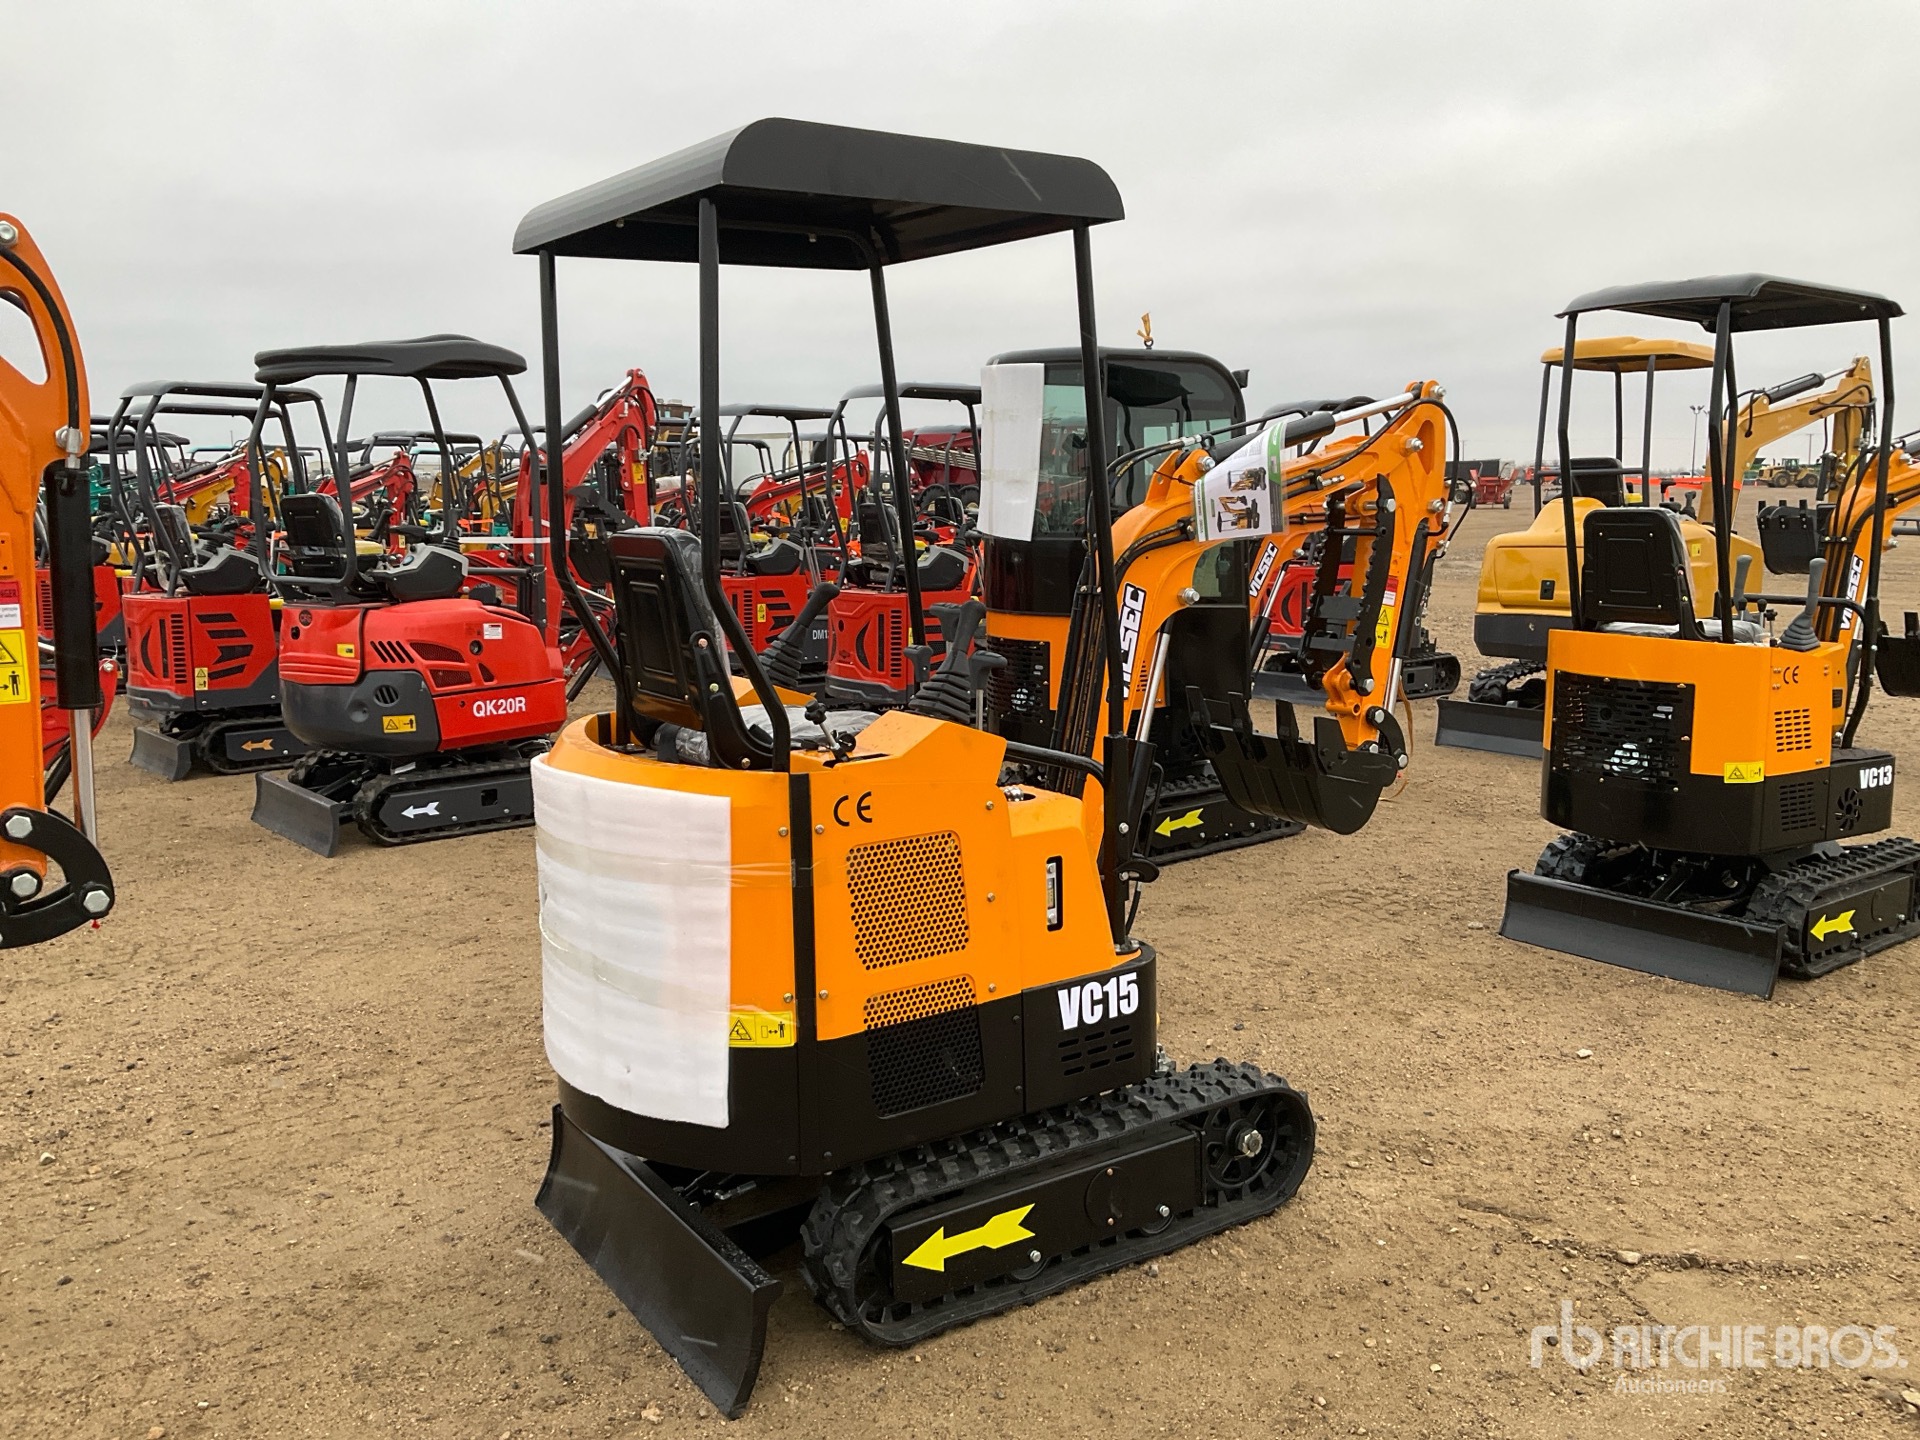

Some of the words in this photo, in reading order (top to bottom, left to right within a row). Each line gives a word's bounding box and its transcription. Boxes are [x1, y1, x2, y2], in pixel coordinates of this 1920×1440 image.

[1249, 542, 1278, 597] VICSEC
[1841, 555, 1864, 630] VISEC
[812, 629, 829, 640] DM1
[473, 696, 526, 717] QK20R
[1859, 765, 1893, 790] VC13
[834, 790, 873, 826] CE
[1058, 972, 1140, 1030] VC15
